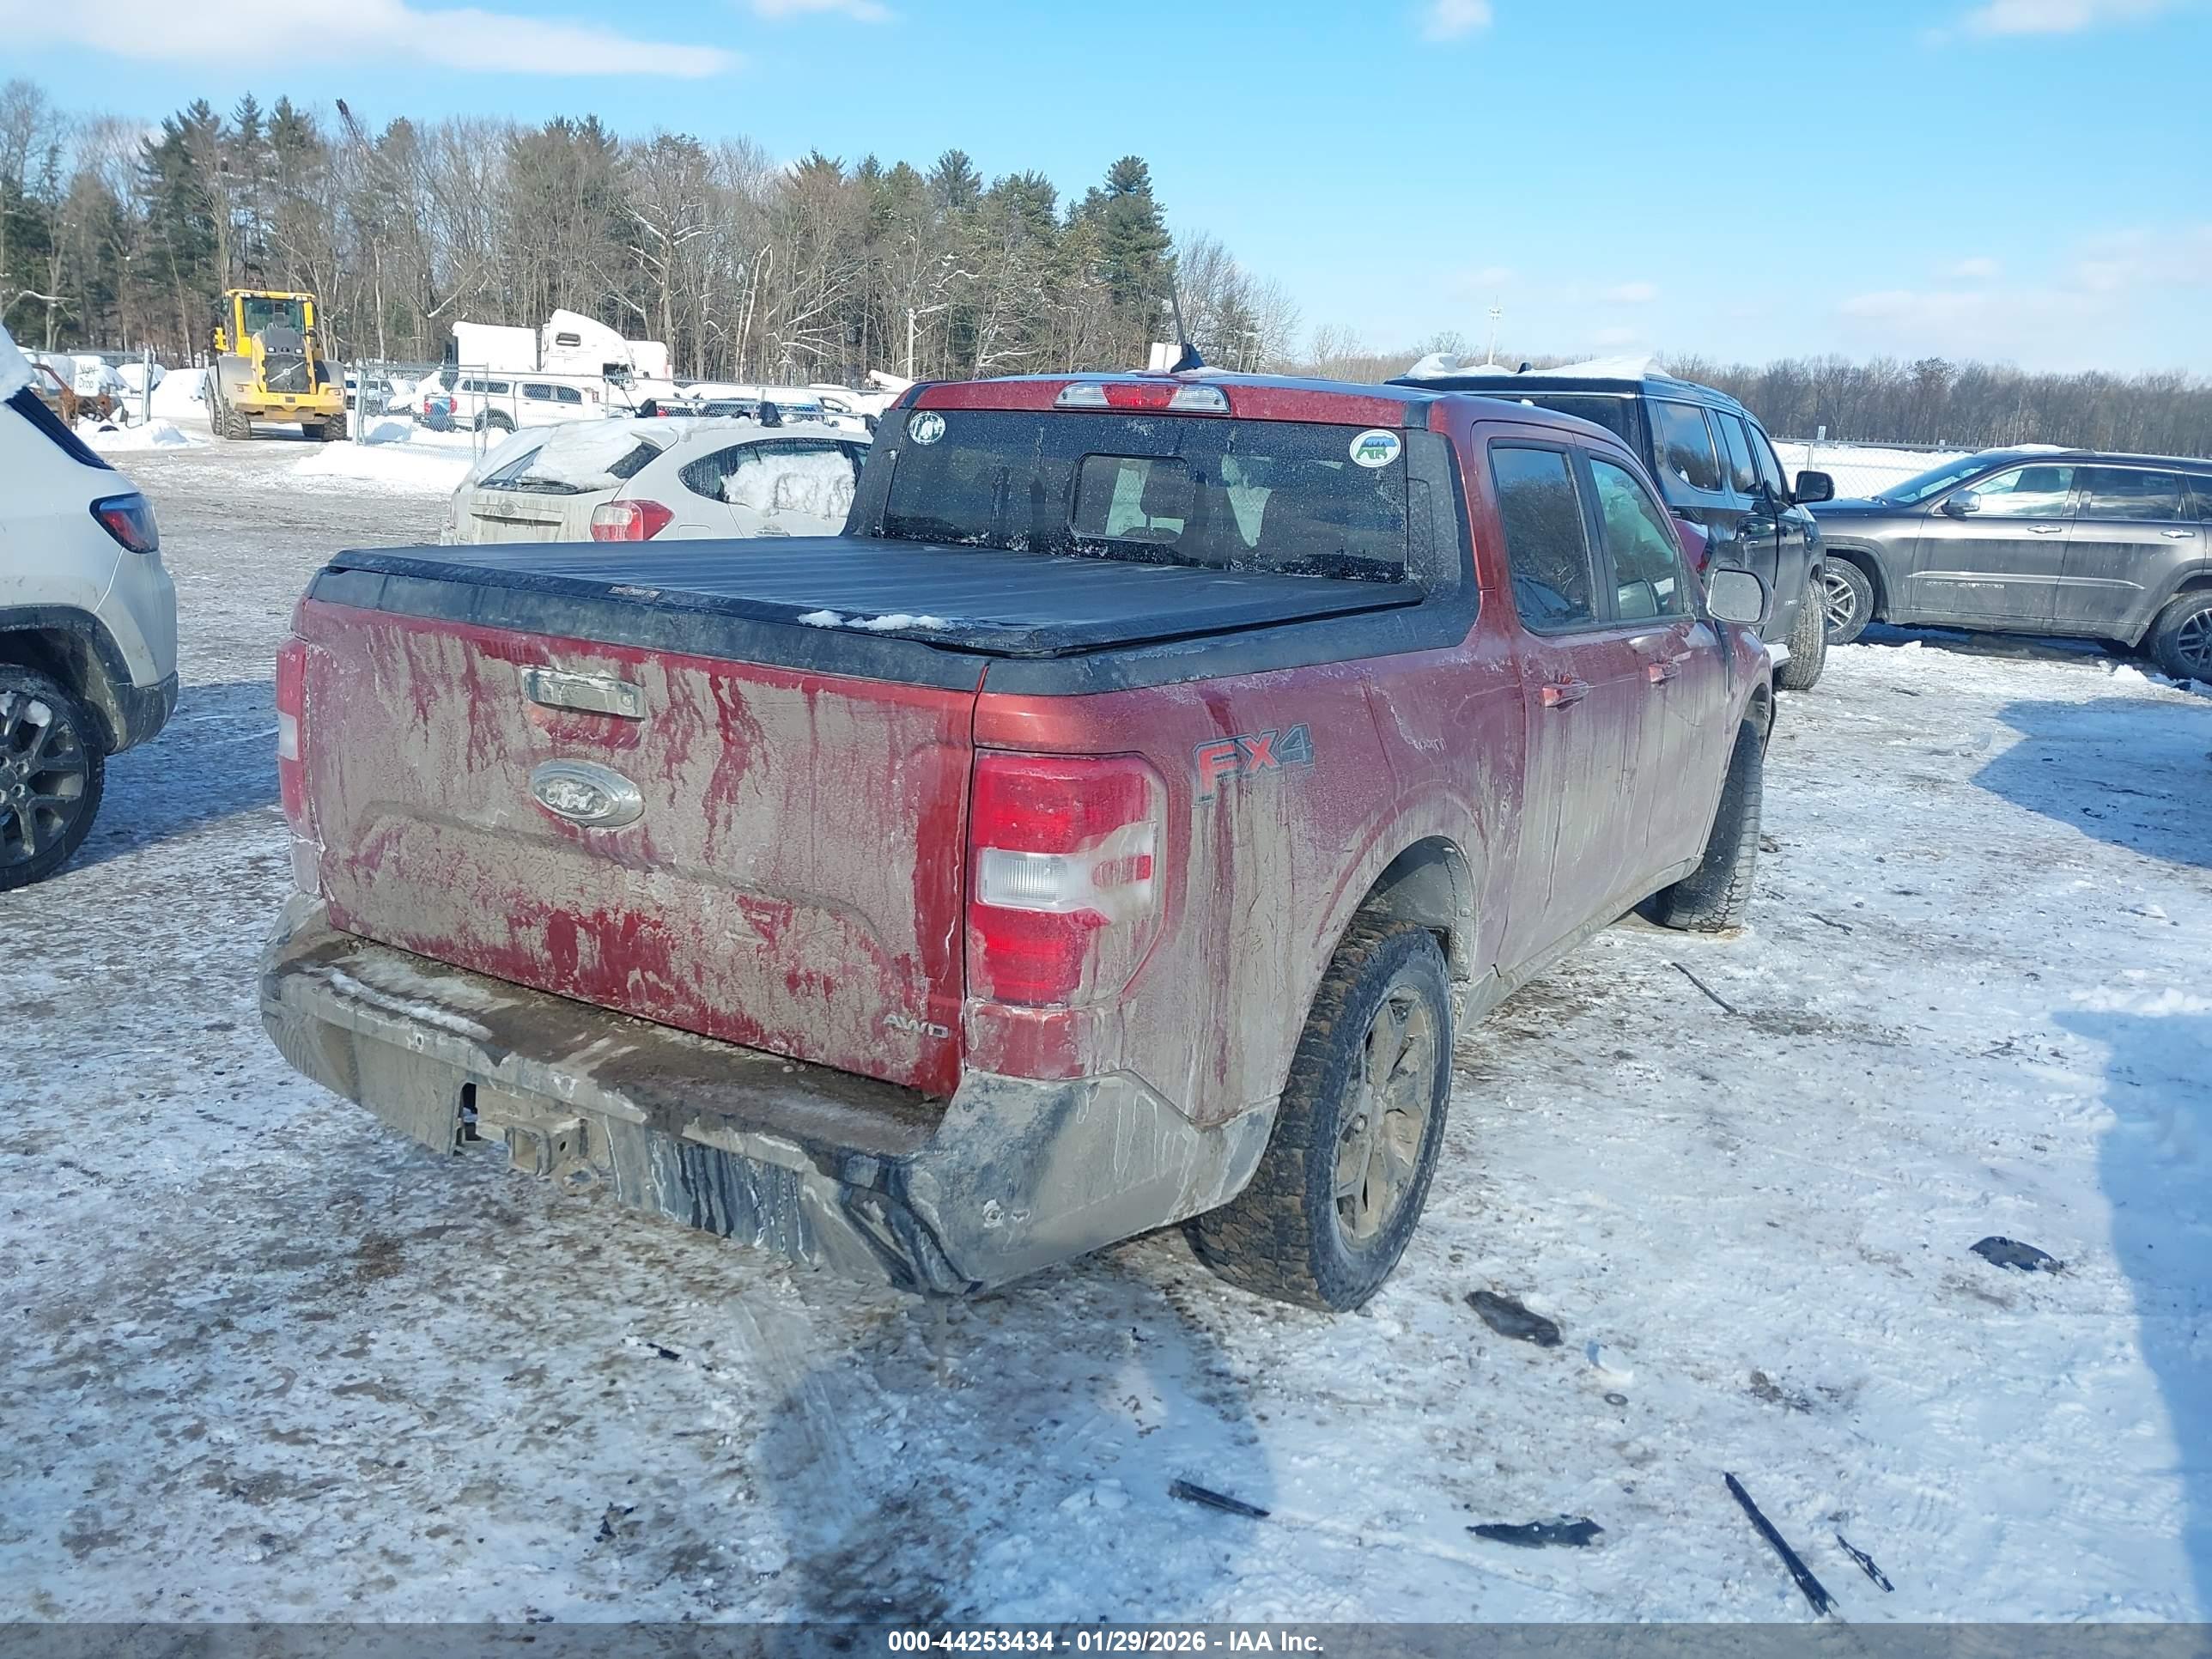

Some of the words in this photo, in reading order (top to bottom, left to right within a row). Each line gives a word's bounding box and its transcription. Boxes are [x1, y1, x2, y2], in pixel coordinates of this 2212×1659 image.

[78, 377, 94, 391] Drop
[1193, 722, 1316, 805] FX4
[882, 1012, 949, 1039] AWD
